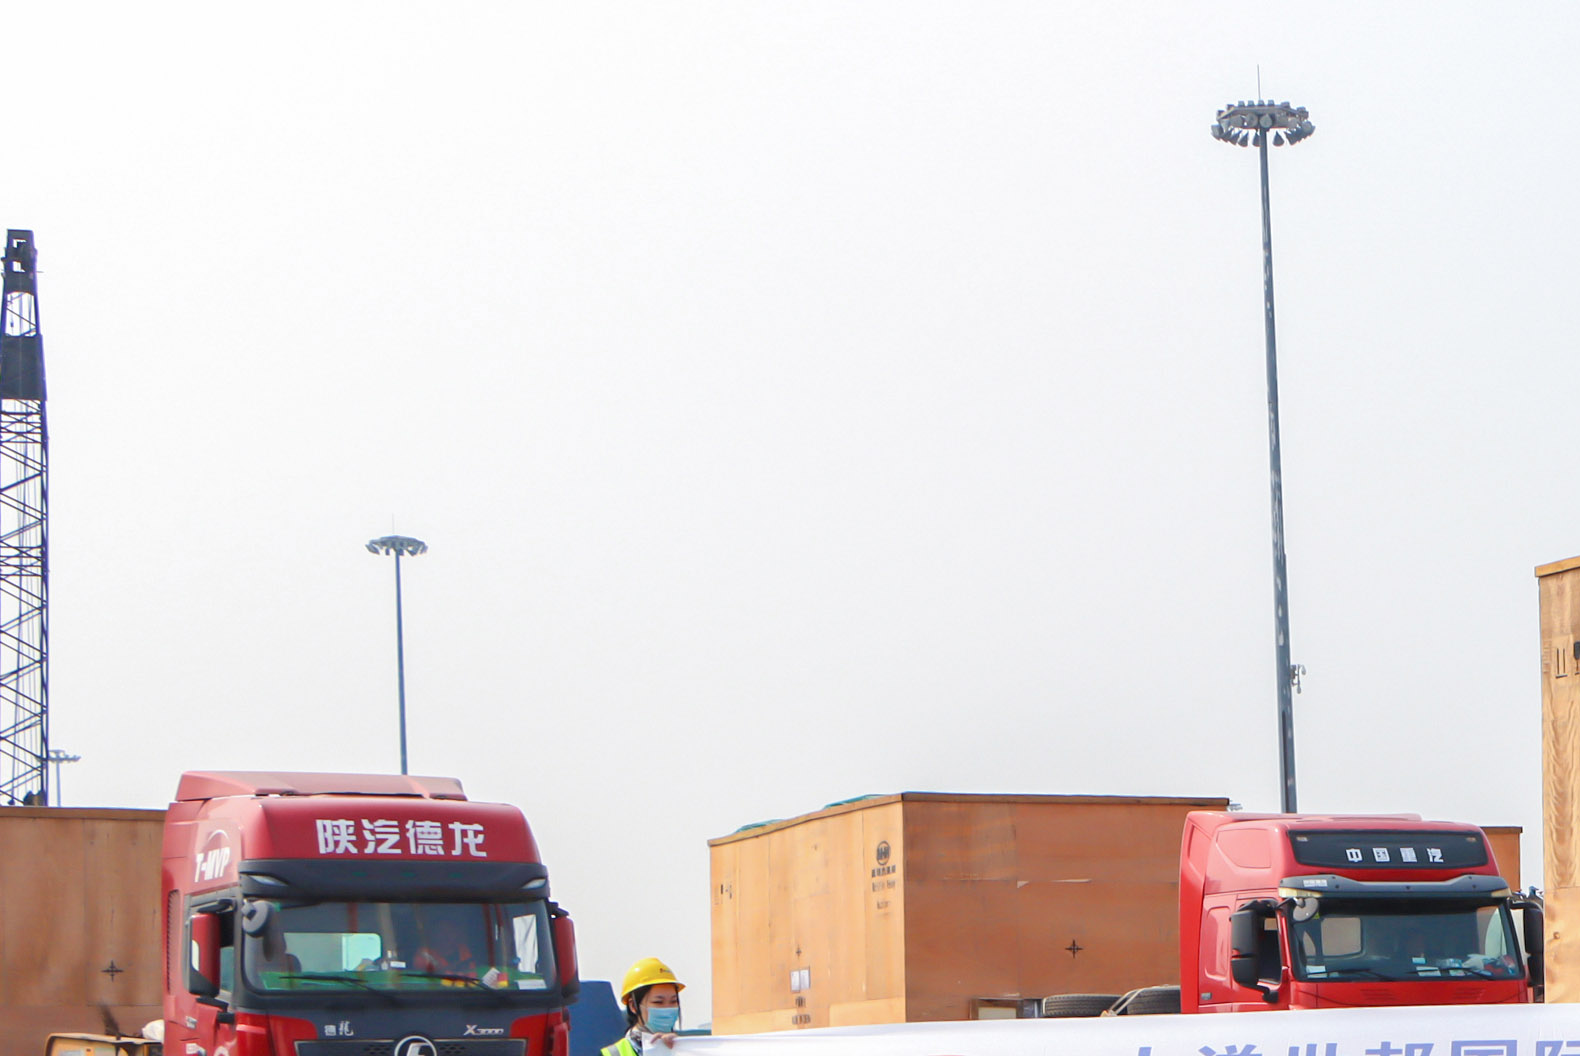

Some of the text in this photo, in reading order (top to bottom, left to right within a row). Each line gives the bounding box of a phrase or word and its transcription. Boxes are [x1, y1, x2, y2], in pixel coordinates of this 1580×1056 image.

[315, 819, 488, 857] 陕汽德龙
[1345, 847, 1444, 863] 中国重汽
